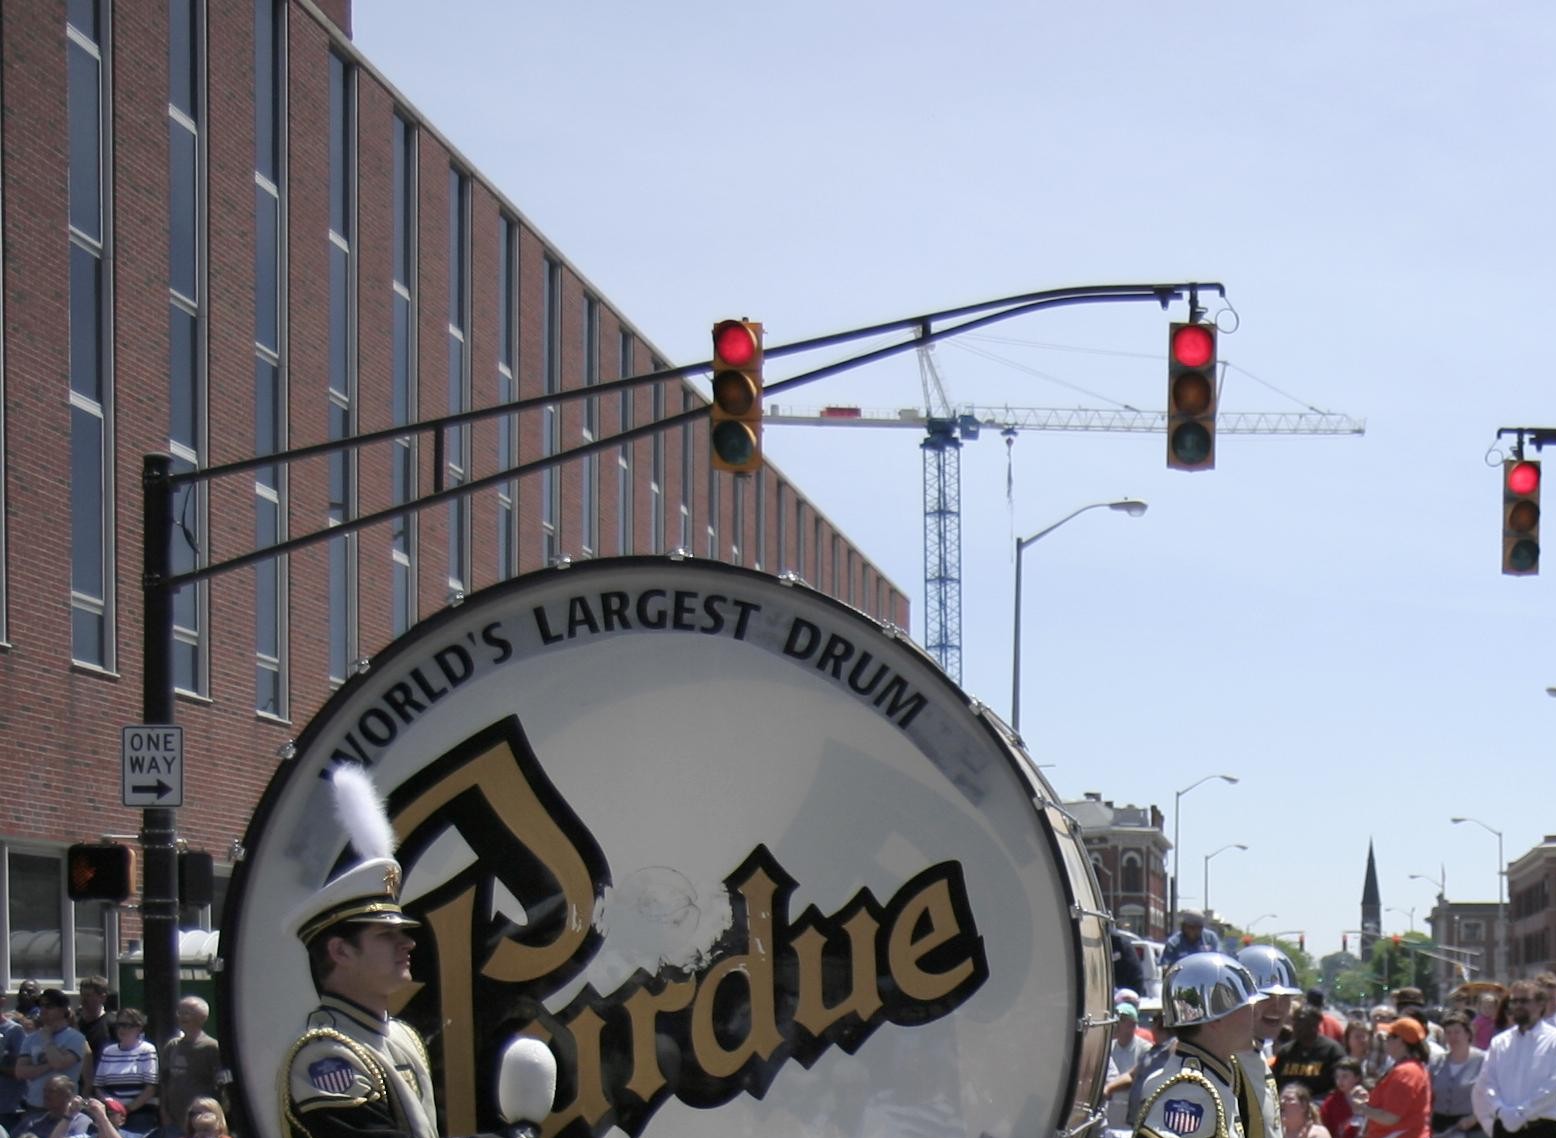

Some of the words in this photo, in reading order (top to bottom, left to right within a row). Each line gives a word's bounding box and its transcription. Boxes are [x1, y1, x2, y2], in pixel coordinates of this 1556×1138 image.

[320, 620, 513, 782] WORLD'S
[533, 588, 762, 646] LARGEST
[782, 616, 928, 731] DRUM
[130, 733, 175, 752] ONE
[129, 756, 176, 775] WAY
